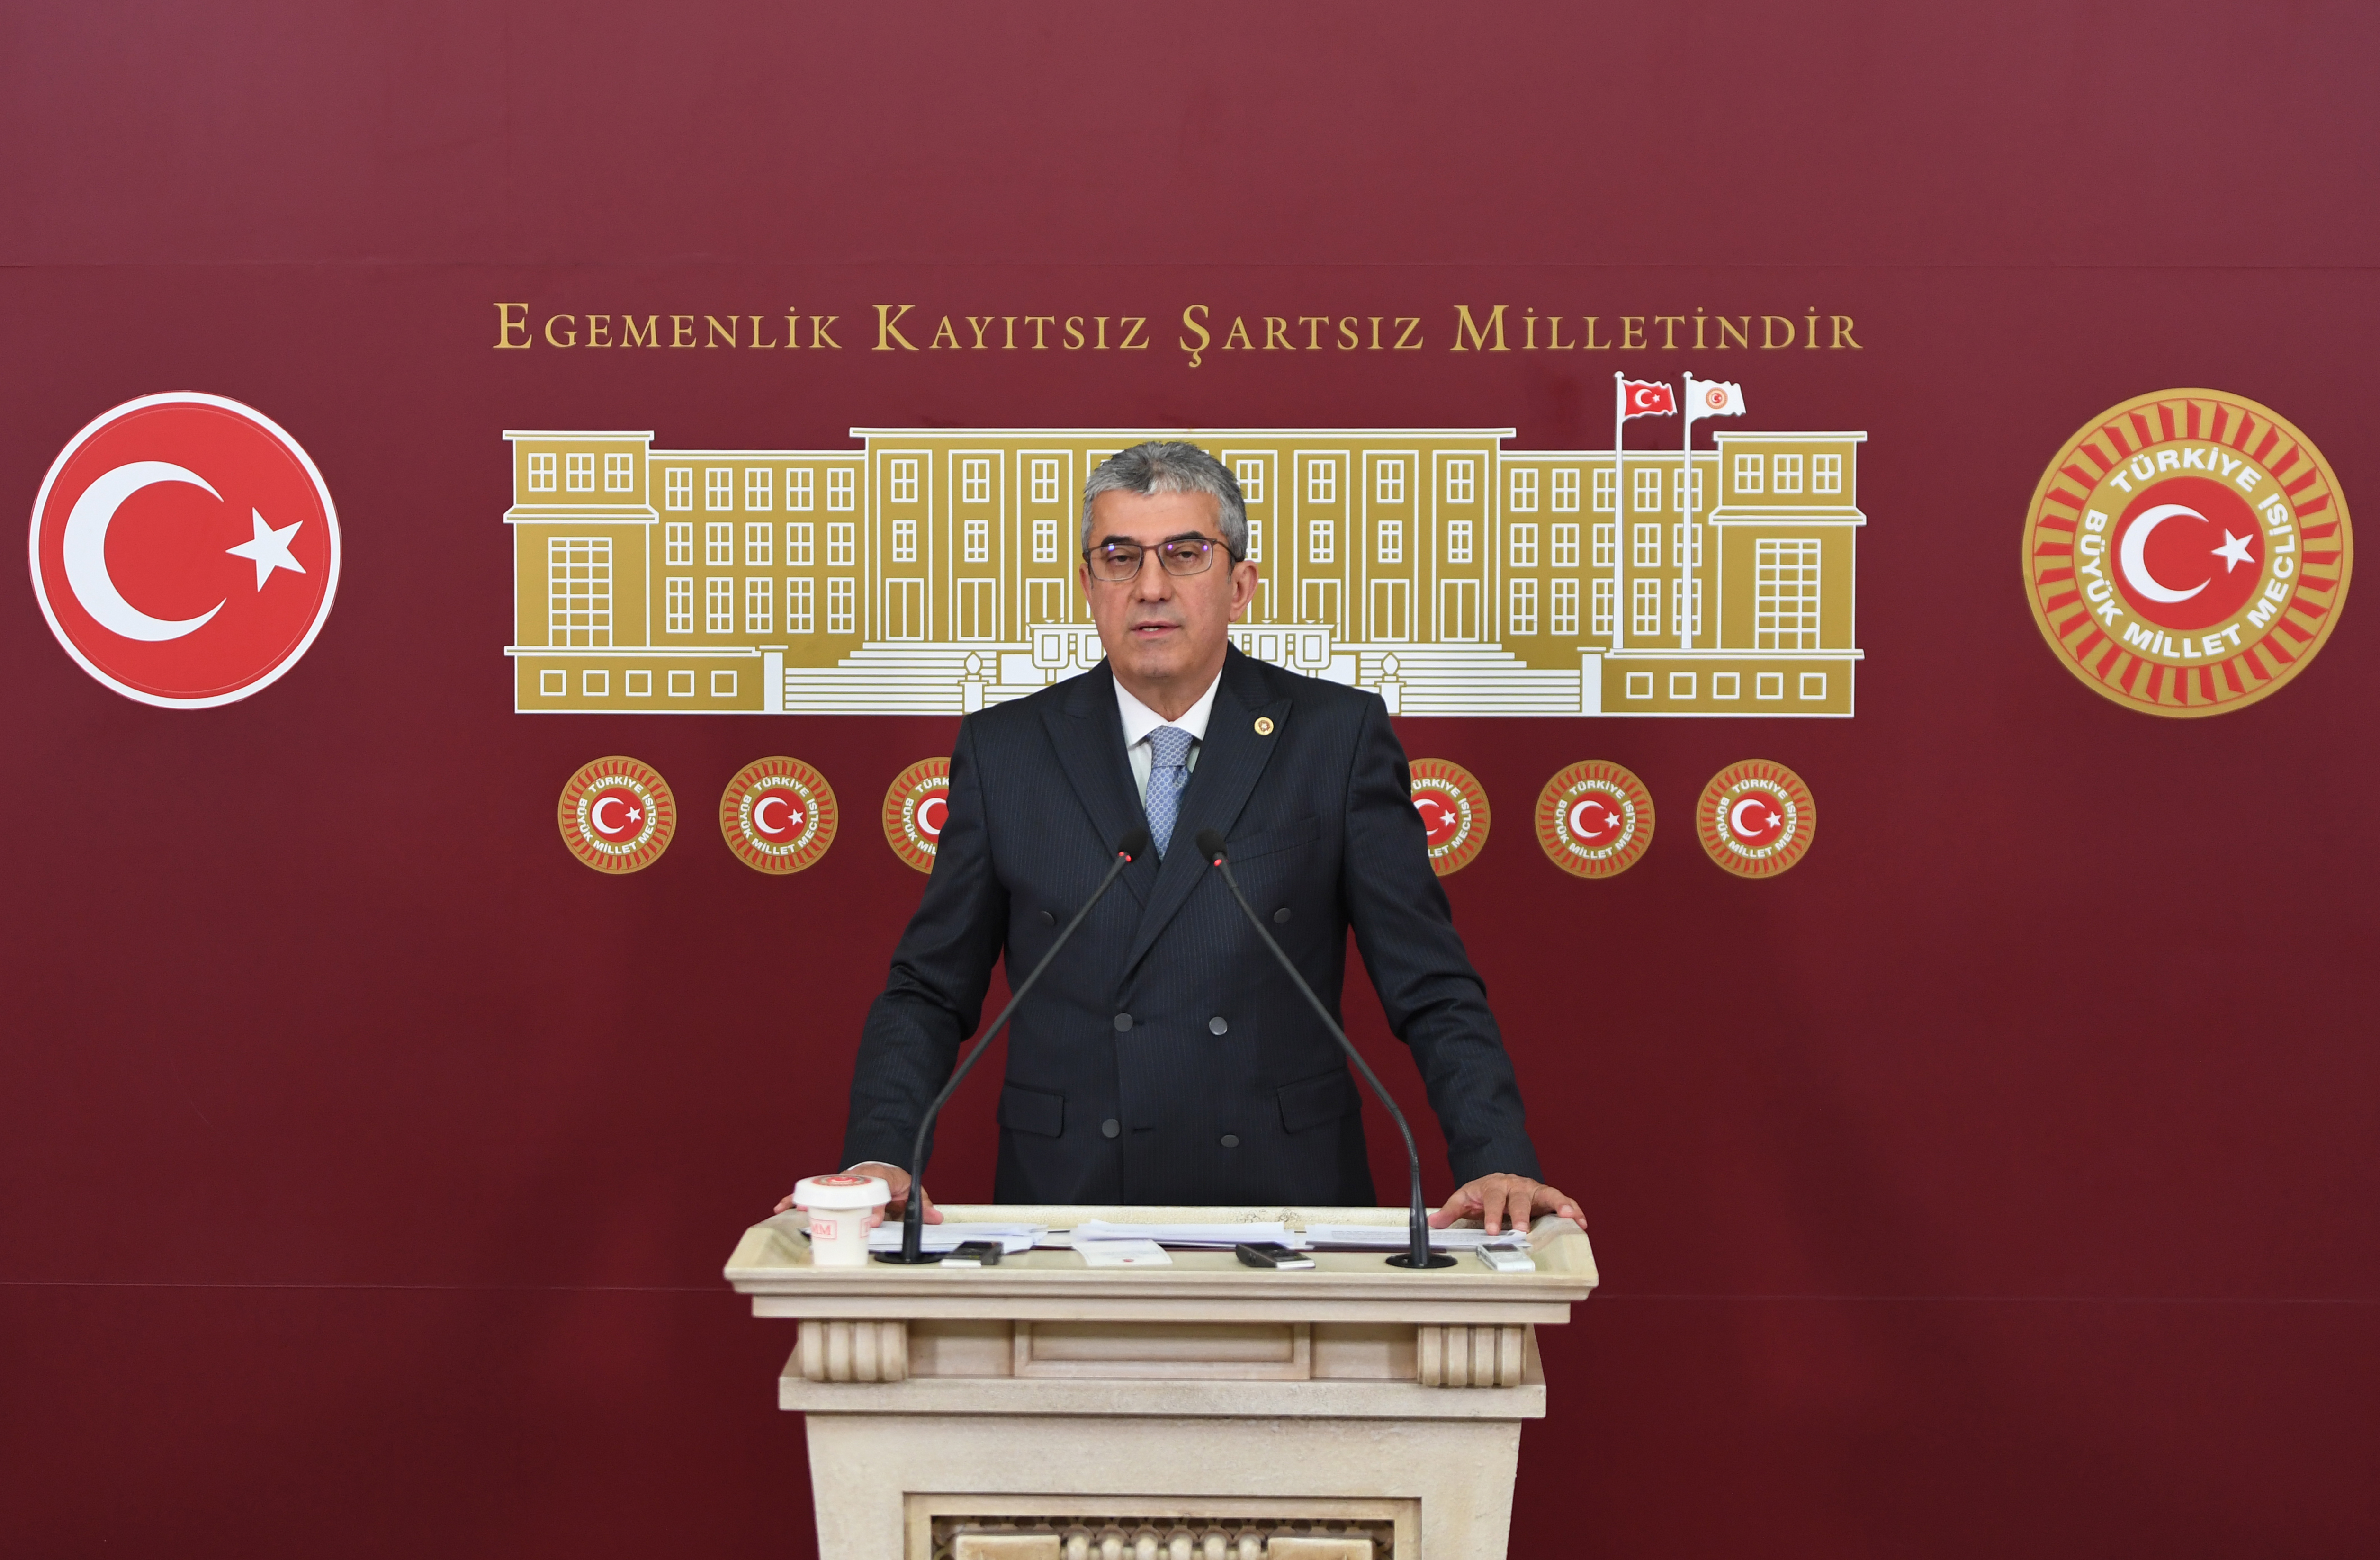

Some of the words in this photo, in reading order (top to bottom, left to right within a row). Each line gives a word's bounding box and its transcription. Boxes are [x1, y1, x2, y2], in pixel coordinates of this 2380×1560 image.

[493, 302, 841, 349] EGEMENLİK
[872, 304, 1150, 351] KAYITSIZ
[1179, 304, 1424, 368] ŞARTSIZ
[1450, 305, 1864, 351] MİLLETİNDİR
[2110, 447, 2262, 493] TÜRKİYE
[2080, 509, 2124, 627] BÜYÜK
[2123, 622, 2241, 658] MİLLET
[588, 776, 644, 794] TÜRKİYE
[754, 777, 809, 797] TÜRKİYE
[915, 777, 949, 793] TÜRK
[1410, 779, 1461, 798] ÜRKİYE
[1569, 780, 1625, 799] TÜRKİYE
[1732, 779, 1788, 800] TÜRKİYE
[577, 798, 593, 842] BÜYÜK
[593, 840, 636, 854] MİLLET
[739, 795, 753, 838] BÜYÜK
[752, 838, 795, 855] MİLLET
[903, 798, 918, 842] BÜYÜK
[917, 840, 936, 855] MİL
[1555, 799, 1569, 844] BÜYÜK
[1569, 843, 1612, 859] MİLLET
[1716, 797, 1730, 841] BÜYÜK
[1728, 840, 1772, 858] MİLLET
[1428, 845, 1449, 858] LET
